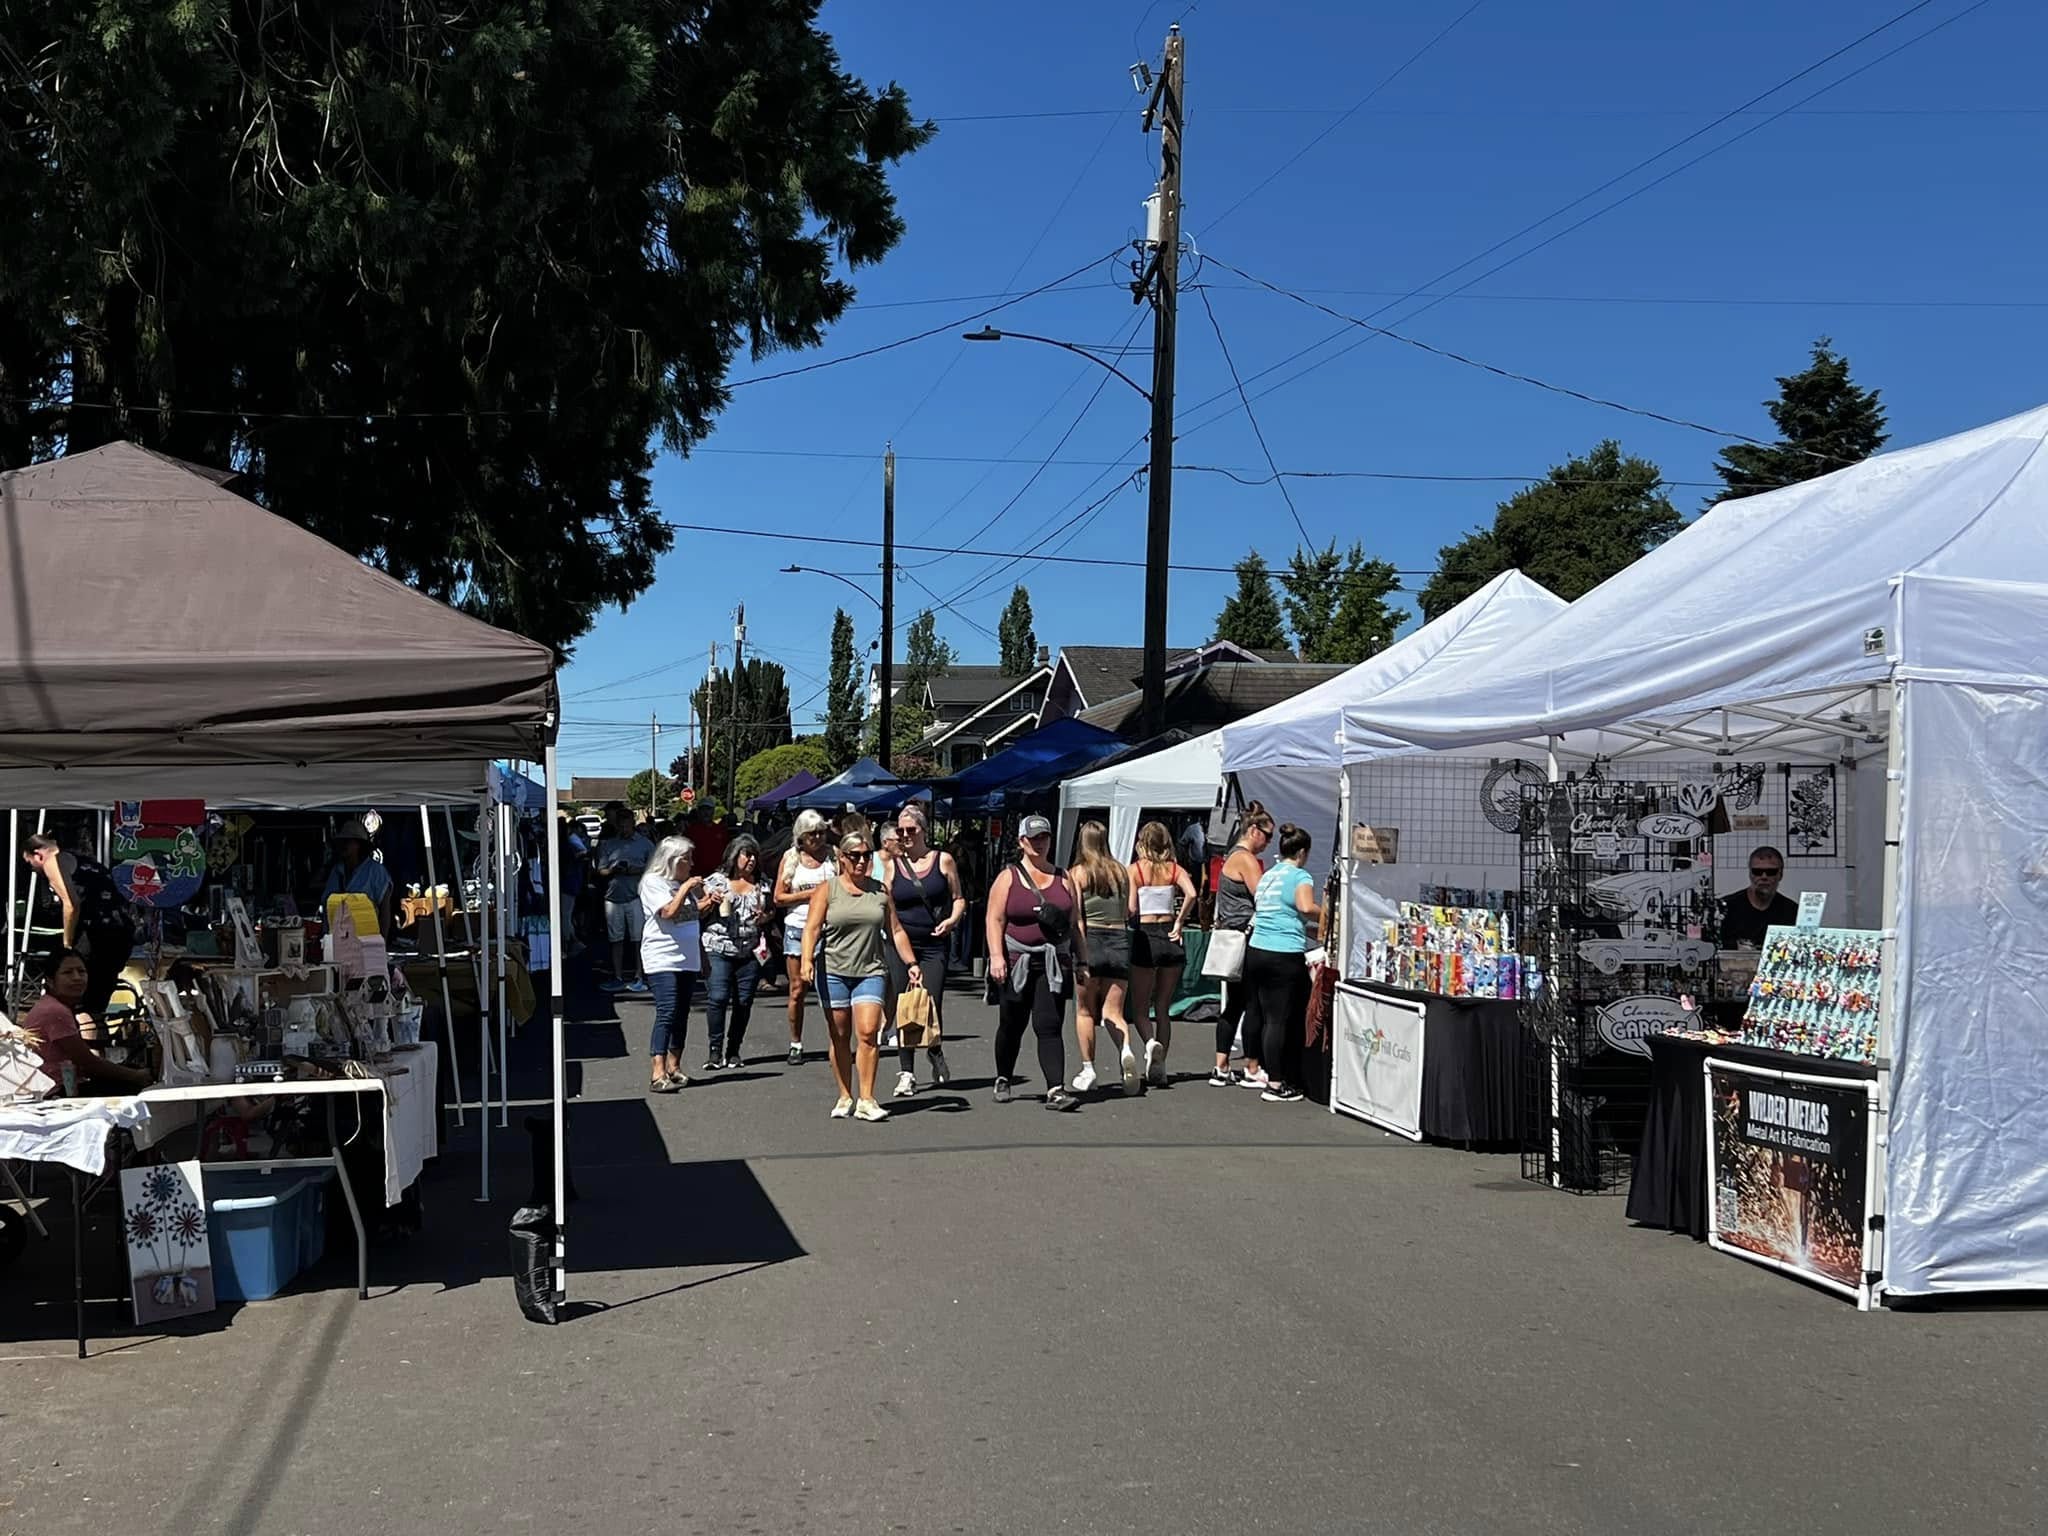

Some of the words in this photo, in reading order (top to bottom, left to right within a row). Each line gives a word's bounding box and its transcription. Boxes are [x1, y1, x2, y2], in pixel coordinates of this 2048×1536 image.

[1652, 817, 1691, 836] Ford
[1748, 1090, 1787, 1127] WILDER
[1788, 1098, 1829, 1135] METALS
[1746, 1122, 1768, 1140] Metal
[1768, 1127, 1780, 1143] Art
[1781, 1129, 1787, 1145] &
[1788, 1131, 1831, 1154] Fabrication
